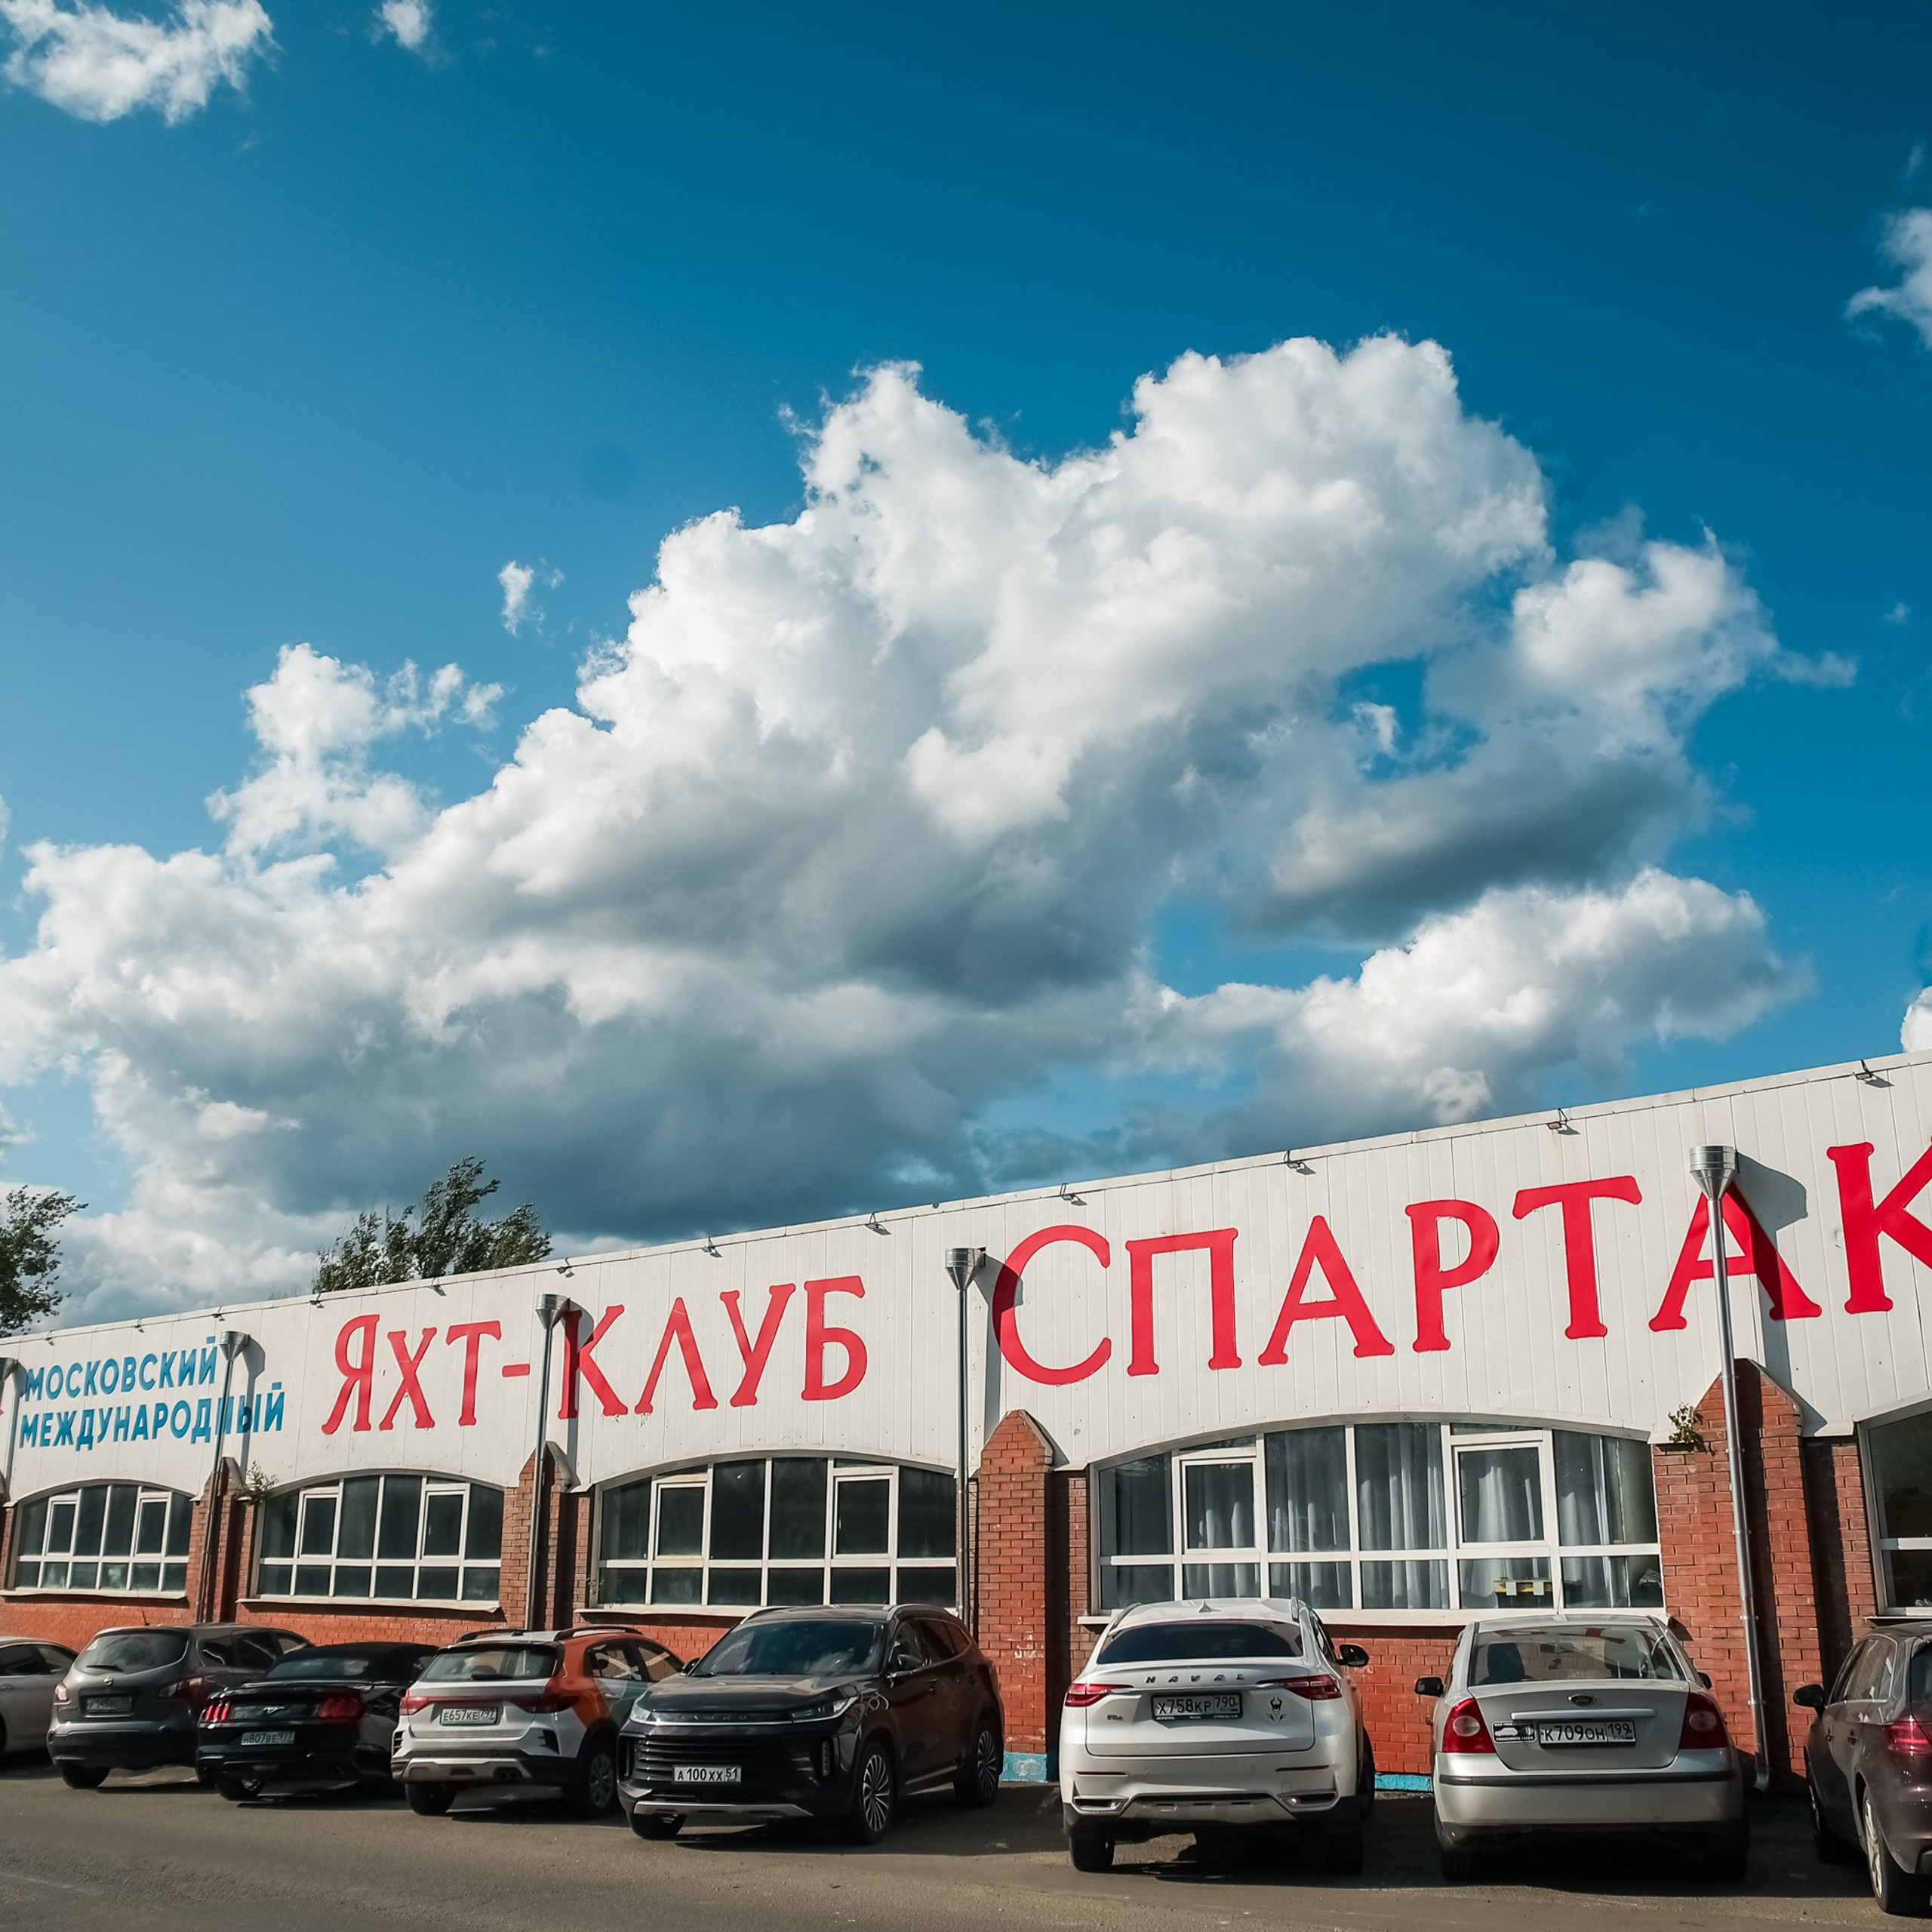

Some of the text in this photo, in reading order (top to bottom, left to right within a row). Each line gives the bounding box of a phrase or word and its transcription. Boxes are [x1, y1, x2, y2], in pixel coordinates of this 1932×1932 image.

[321, 1135, 1932, 1435] ЯХТ-КЛУБ СПАРТАК
[24, 1336, 217, 1401] МОСКОВСКИЙ
[1214, 1697, 1235, 1708] 790
[1607, 1723, 1630, 1735] 199
[725, 1767, 737, 1778] 51
